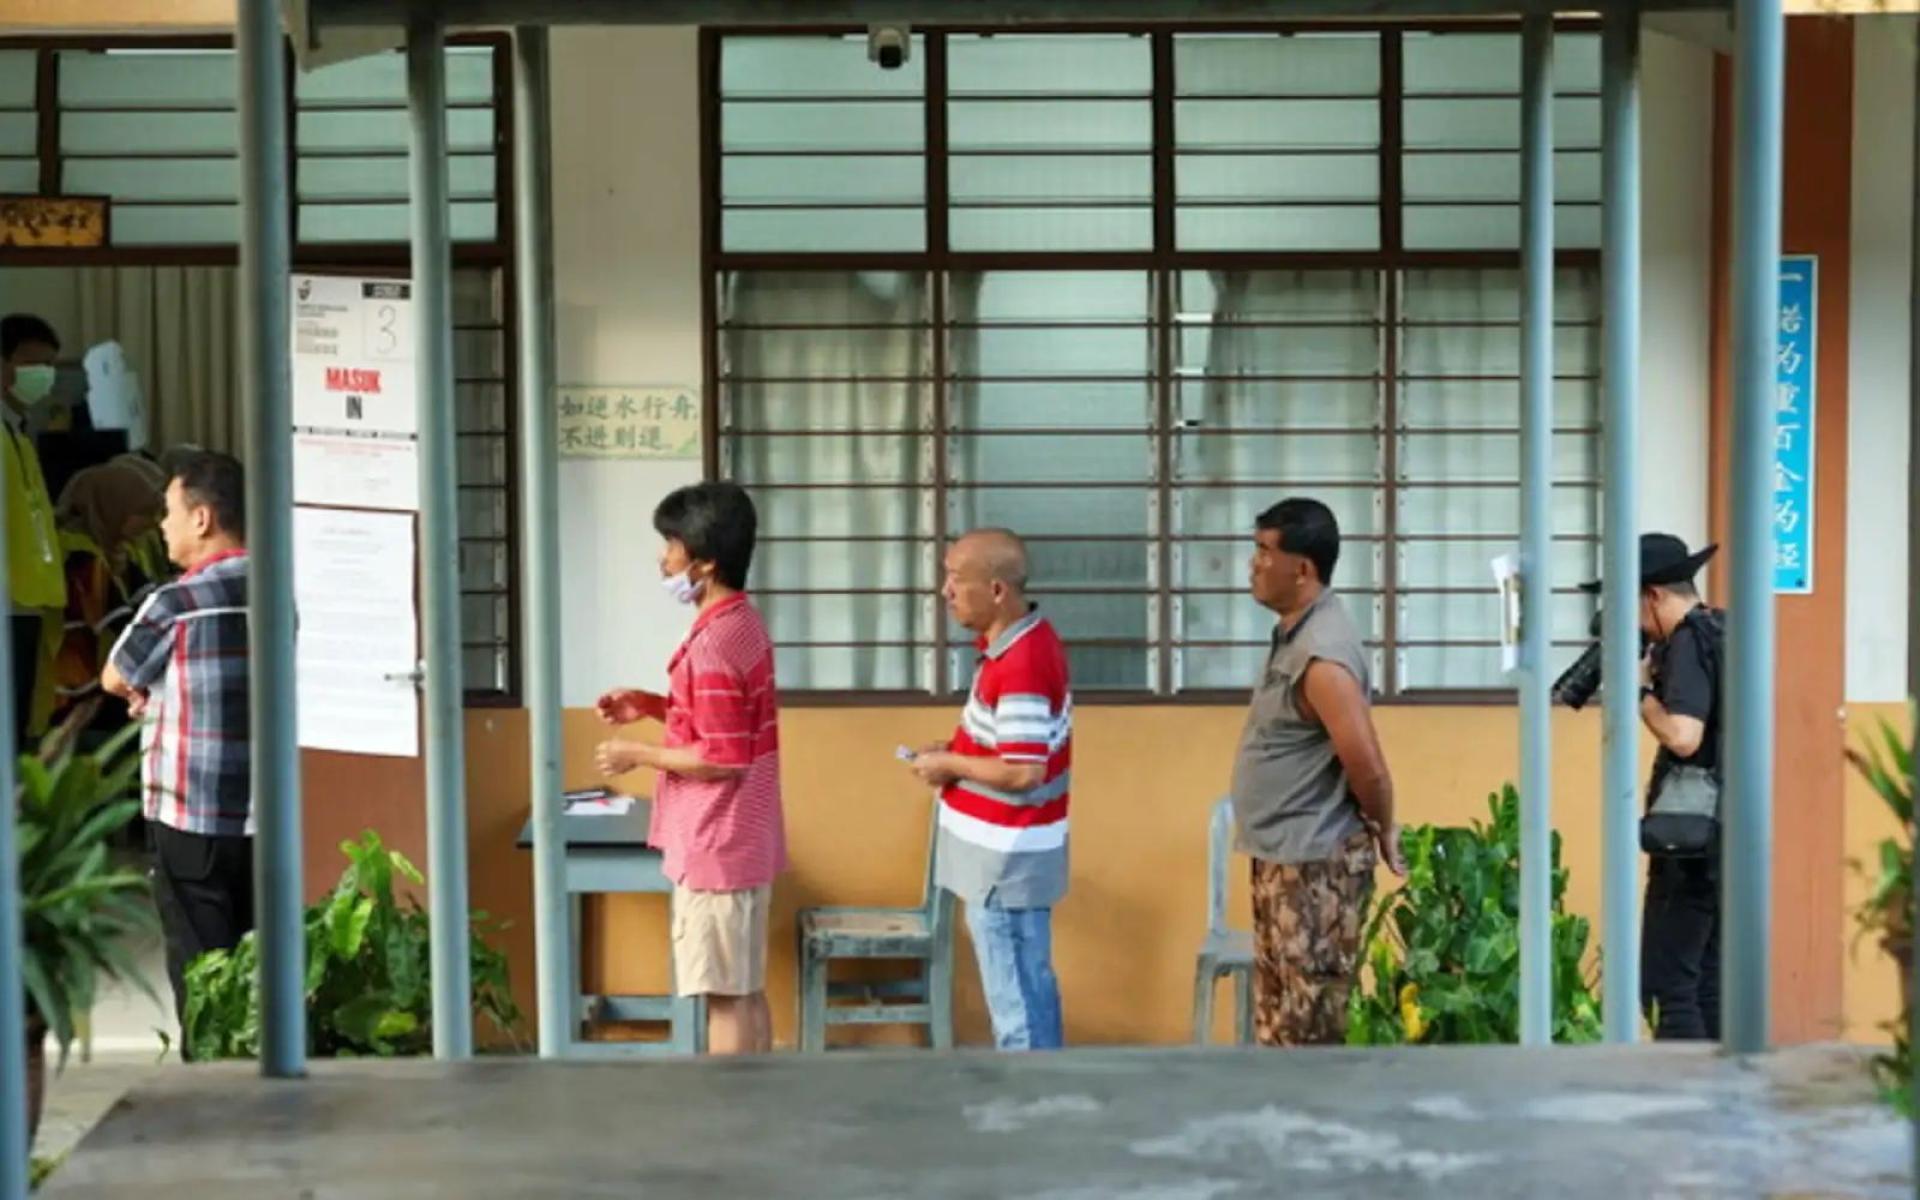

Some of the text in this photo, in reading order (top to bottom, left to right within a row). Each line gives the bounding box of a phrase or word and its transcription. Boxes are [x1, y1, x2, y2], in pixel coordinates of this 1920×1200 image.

[377, 304, 398, 354] 3
[325, 367, 381, 394] MASUK
[346, 395, 363, 419] IN
